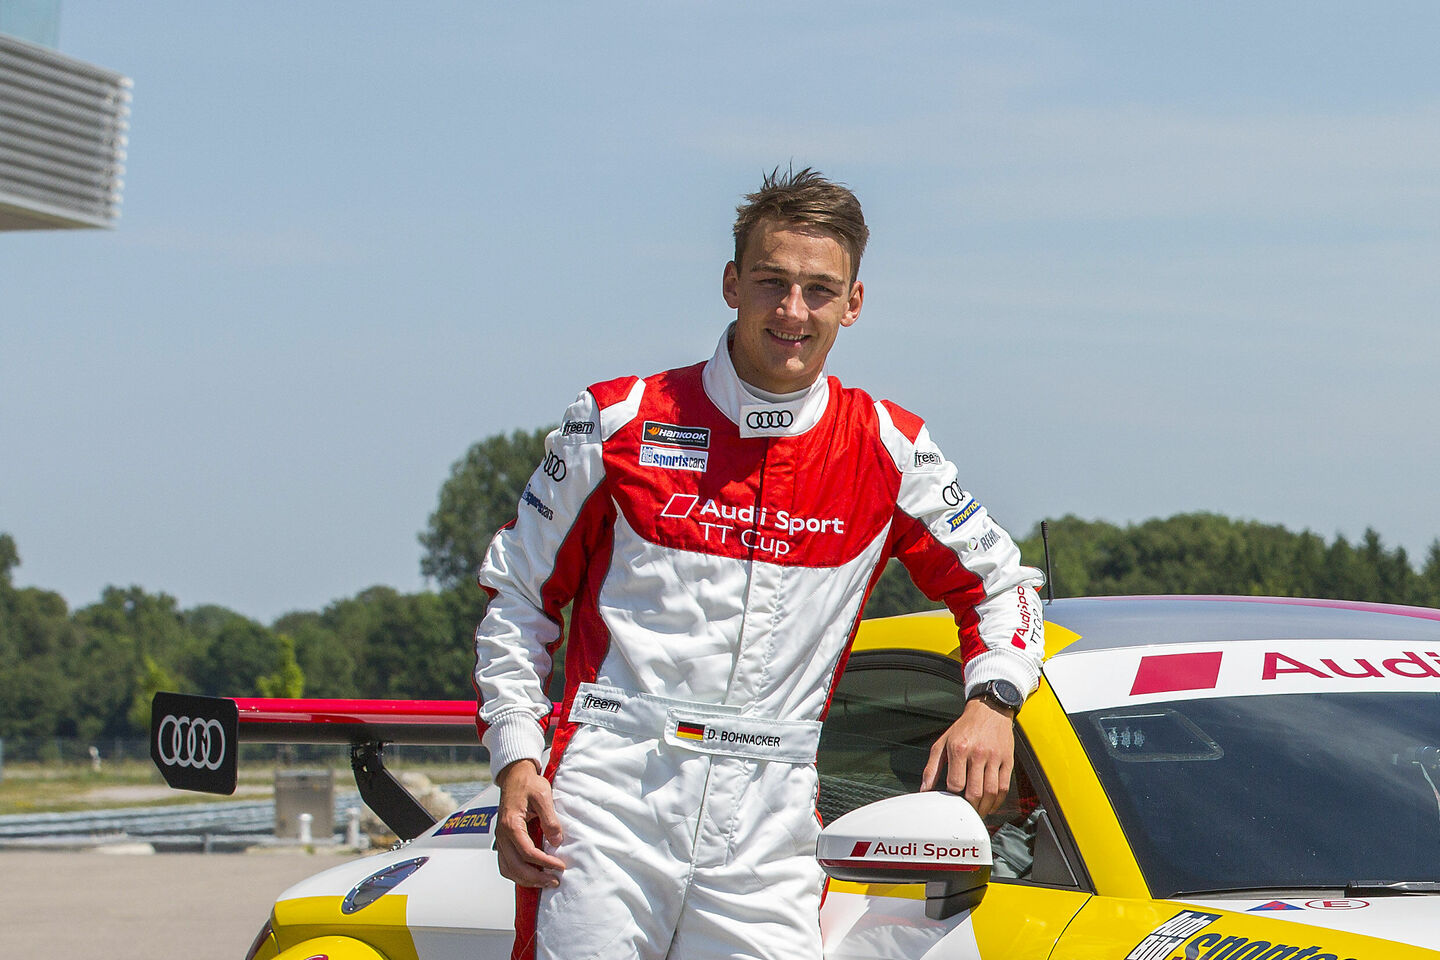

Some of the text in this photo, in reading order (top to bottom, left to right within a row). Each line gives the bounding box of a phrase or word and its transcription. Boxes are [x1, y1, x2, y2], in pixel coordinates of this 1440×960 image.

[700, 499, 844, 536] Audi Sport
[699, 522, 790, 558] TT Cup
[582, 694, 621, 713] freem
[707, 728, 781, 747] D. BOHNACKER
[873, 842, 979, 859] Audi Sport
[1151, 911, 1213, 938] Auto
